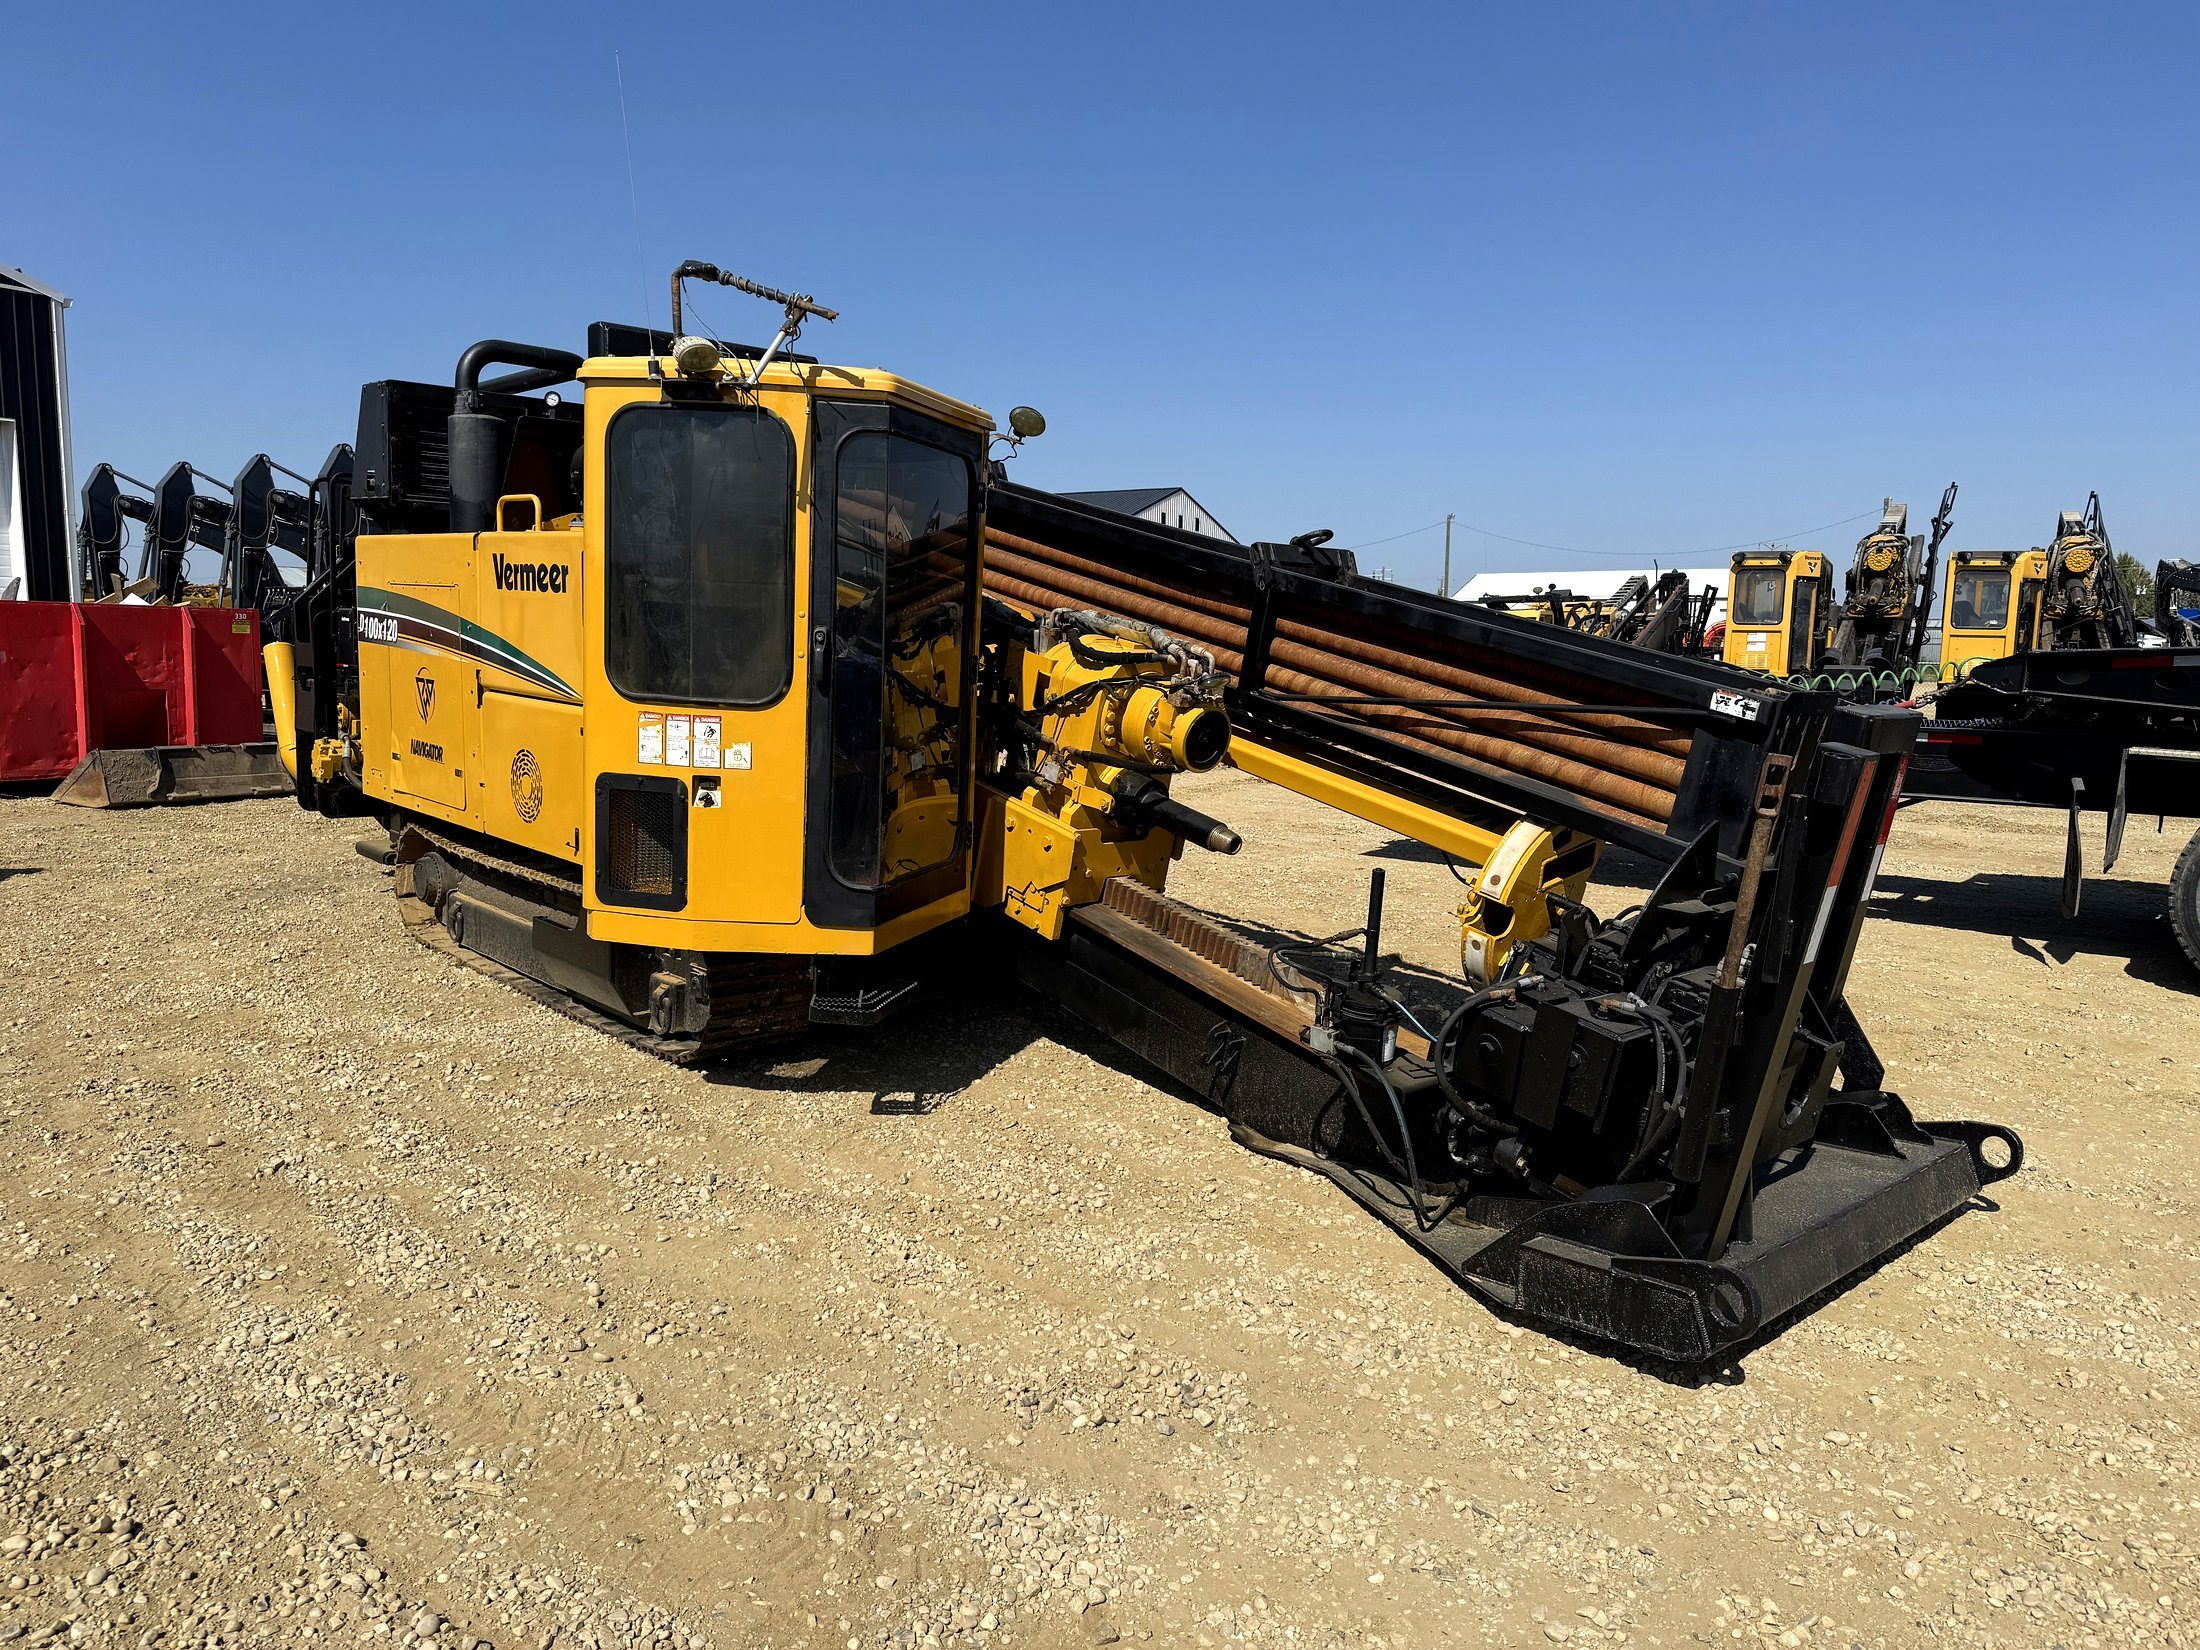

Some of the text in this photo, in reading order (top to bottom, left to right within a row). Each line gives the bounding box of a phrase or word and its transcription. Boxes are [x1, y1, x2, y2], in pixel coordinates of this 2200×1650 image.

[492, 553, 568, 594] Vermeer
[235, 612, 247, 620] 330
[410, 738, 444, 762] NAVIGATOR
